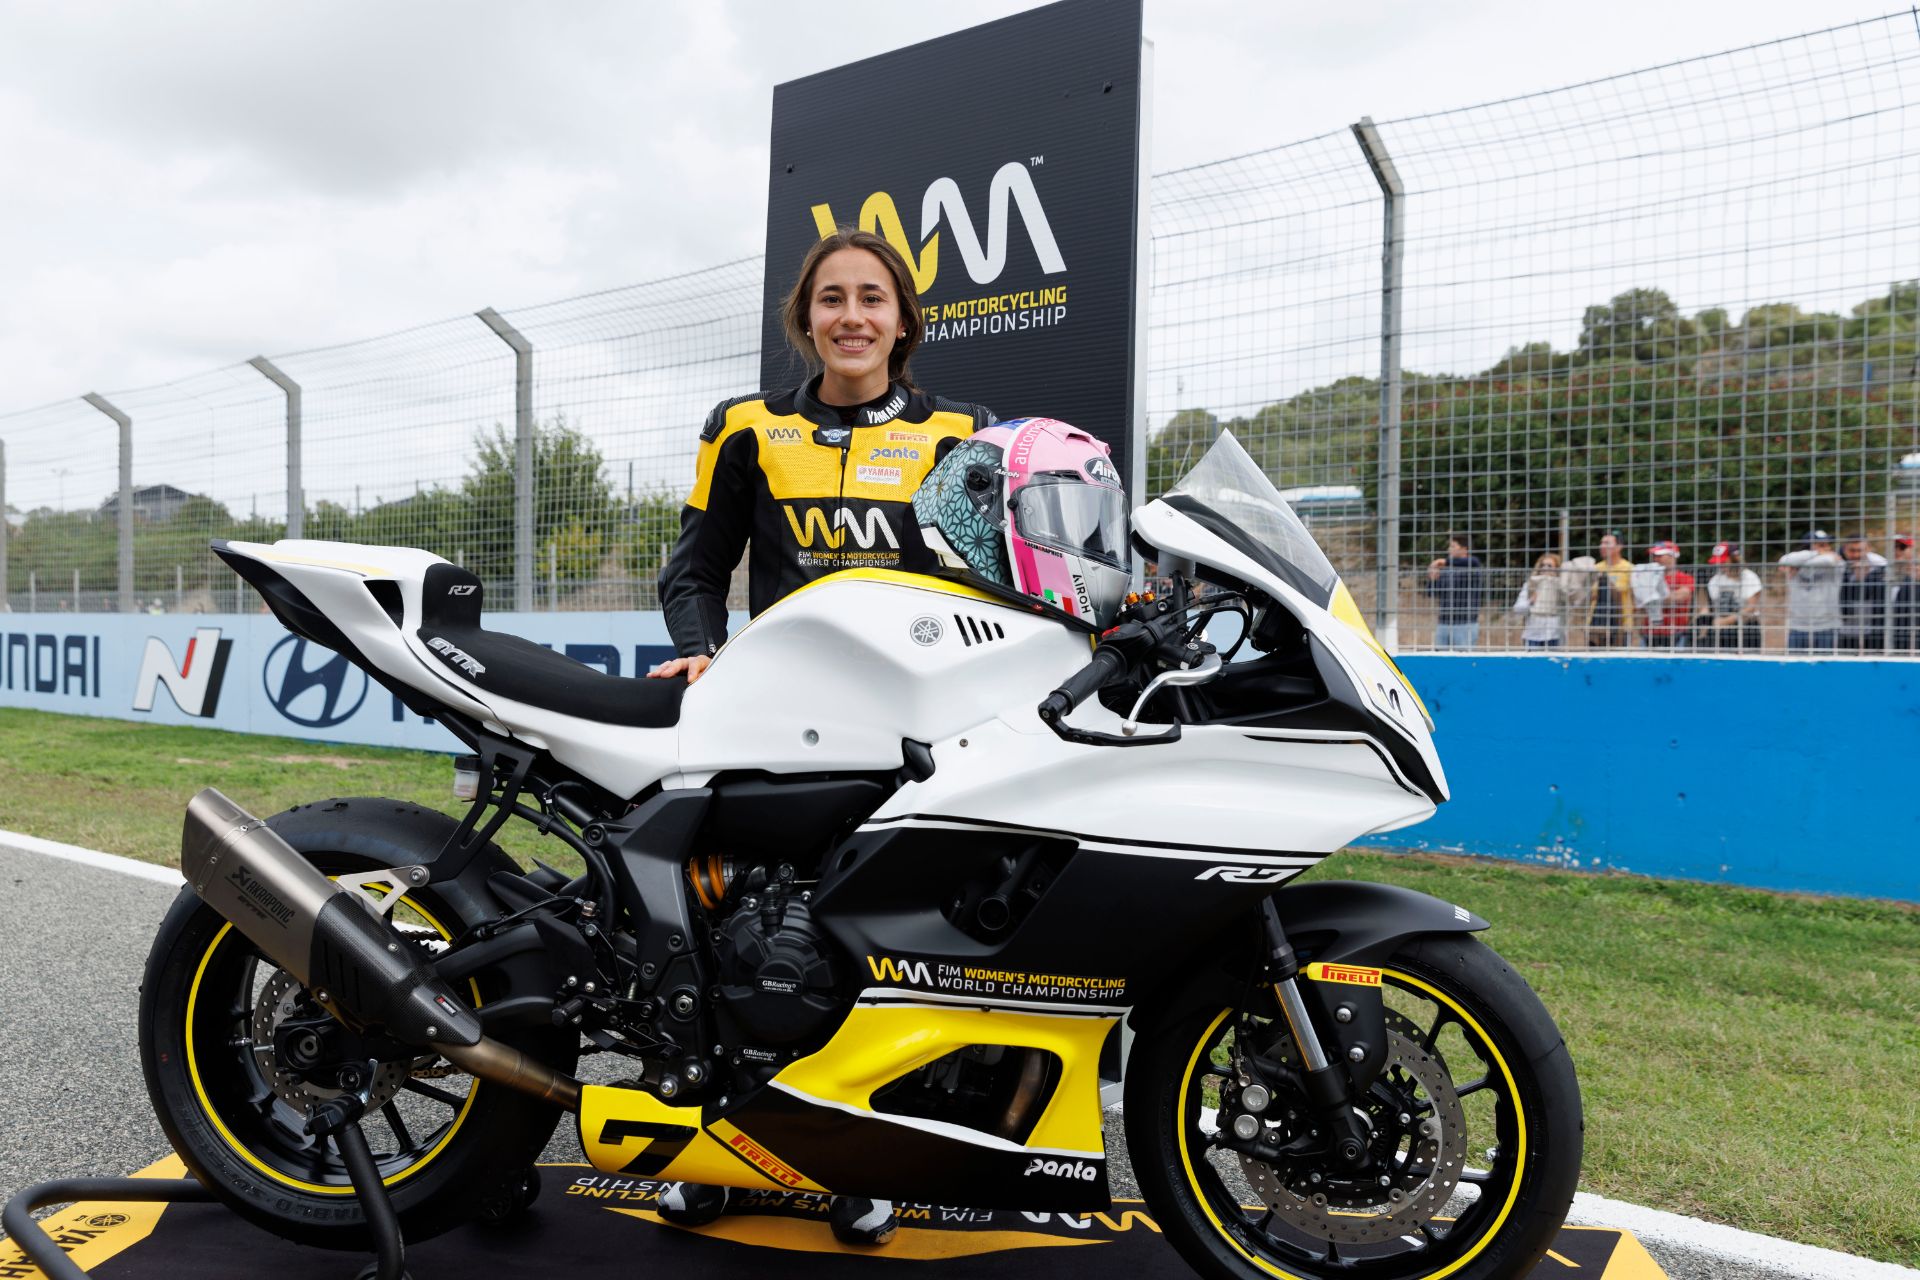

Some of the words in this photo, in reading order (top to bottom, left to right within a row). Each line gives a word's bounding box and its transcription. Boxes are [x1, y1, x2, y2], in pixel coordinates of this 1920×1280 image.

[942, 286, 1067, 320] MOTORCYCLING
[920, 306, 1067, 344] HAMPIONSHIP
[866, 396, 906, 424] YAMAHA
[889, 432, 929, 443] PIRELLI
[870, 447, 920, 461] panta
[867, 468, 901, 478] YAMAHA
[798, 558, 829, 566] WORLD
[832, 559, 900, 567] CHAMPIONSHIP
[448, 585, 477, 596] R7
[1072, 574, 1091, 614] AIROH
[0, 633, 100, 698] NDAI
[426, 637, 486, 679] GYTR
[1194, 865, 1303, 883] R7
[938, 964, 961, 977] FIM
[964, 967, 1026, 983] WOMEN'S
[1028, 974, 1126, 988] MOTORCYCLING
[1321, 965, 1381, 985] PIRELLI
[938, 977, 995, 993] WORLD
[1002, 983, 1125, 999] CHAMPIONSHIP
[598, 1119, 699, 1176] 7
[729, 1133, 803, 1187] PIRELLI
[1023, 1158, 1097, 1182] panta
[942, 1211, 993, 1222] FIM
